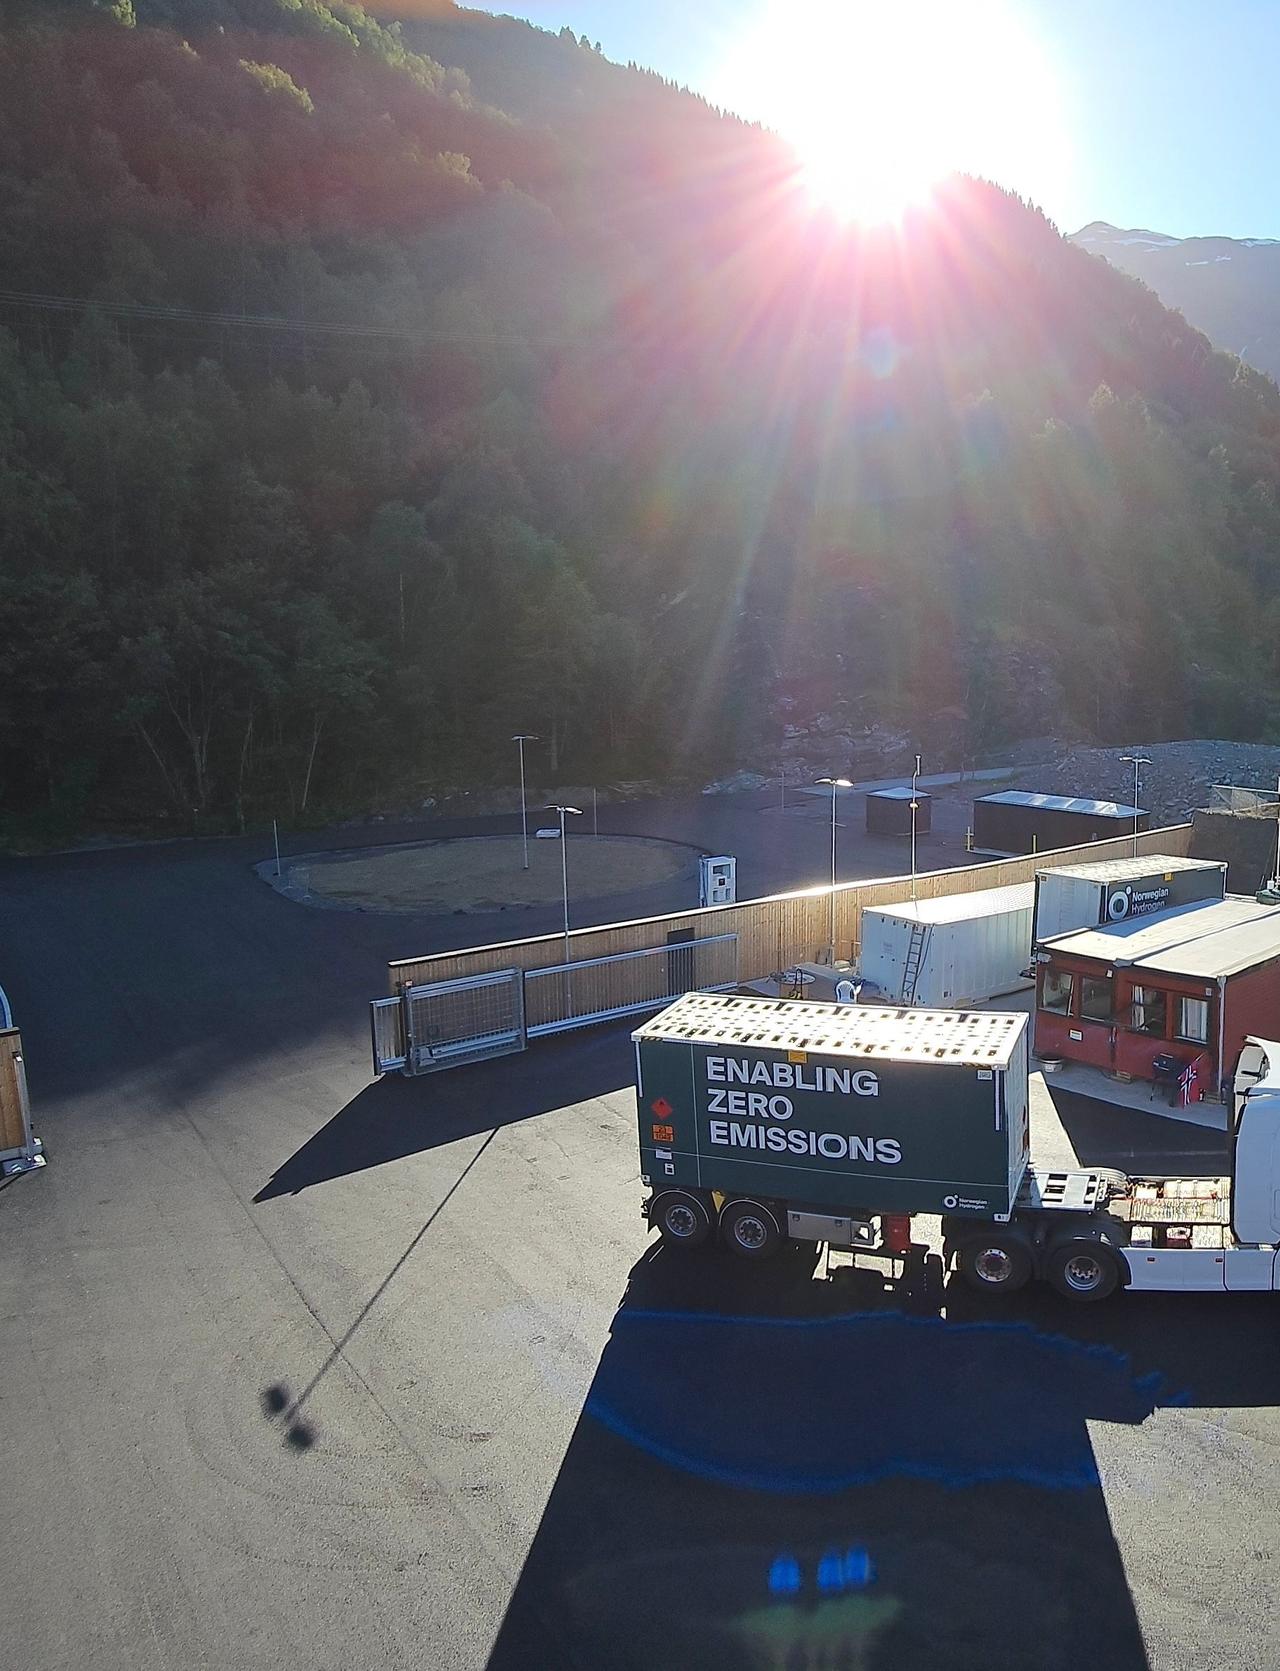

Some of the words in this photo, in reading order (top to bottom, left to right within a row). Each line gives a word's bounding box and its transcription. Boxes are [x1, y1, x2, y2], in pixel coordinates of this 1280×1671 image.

[1131, 901, 1165, 914] Hydrogen
[1132, 888, 1169, 902] Norwegian
[706, 1056, 880, 1097] ENABLING
[707, 1088, 794, 1120] ZERO
[709, 1120, 903, 1164] EMISSIONS
